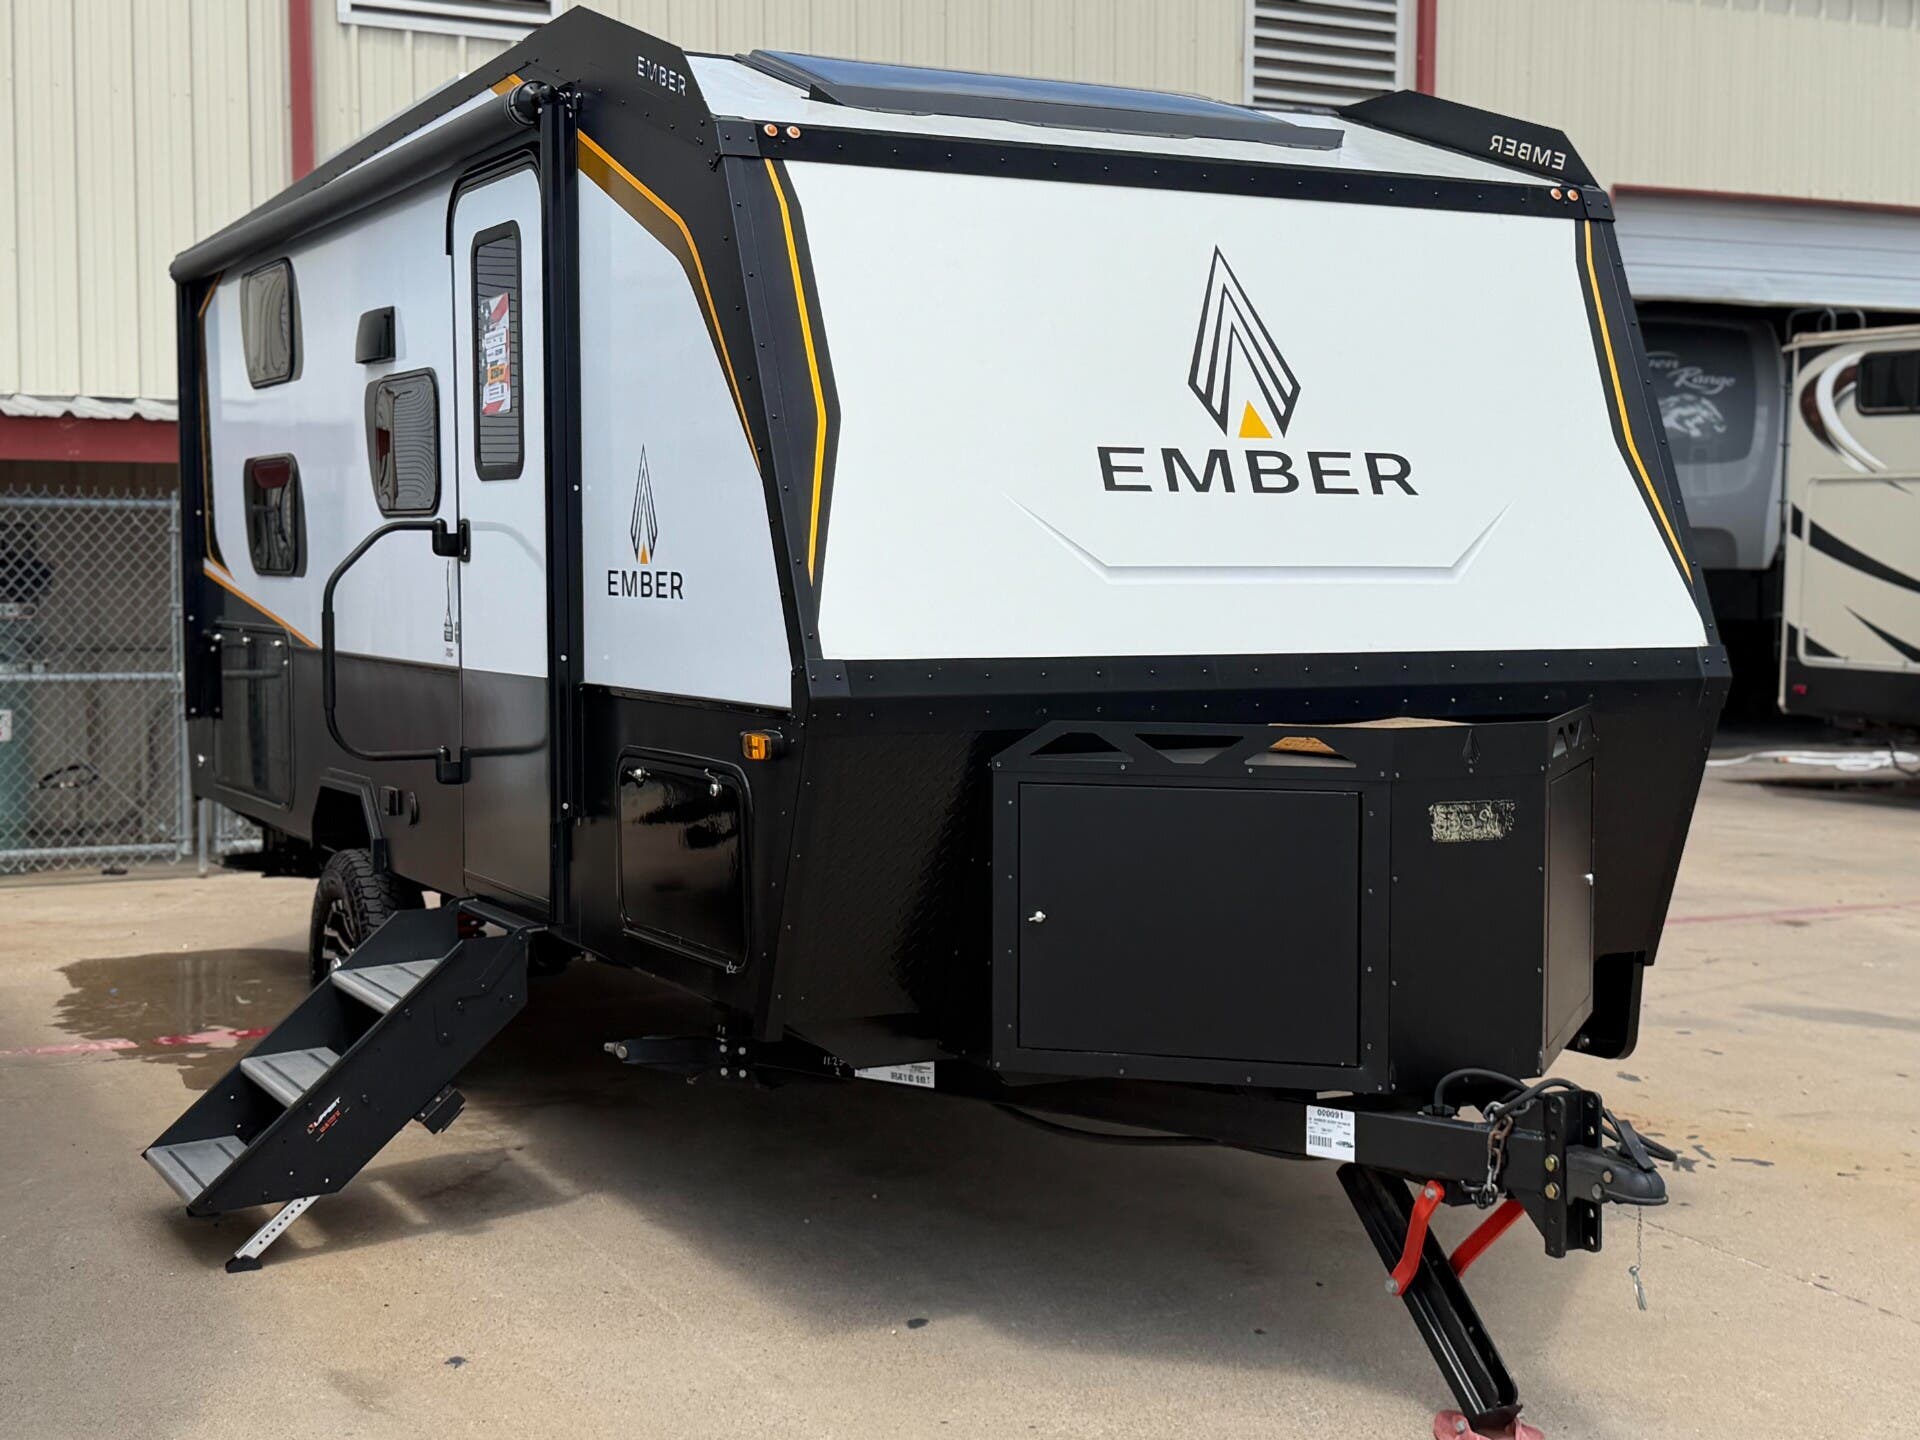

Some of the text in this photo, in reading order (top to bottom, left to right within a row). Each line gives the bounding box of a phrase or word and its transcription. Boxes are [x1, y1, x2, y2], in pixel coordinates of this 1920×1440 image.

[637, 55, 686, 97] EMBER
[1666, 366, 1736, 395] Range
[1097, 446, 1419, 496] EMBER
[607, 569, 684, 600] EMBER
